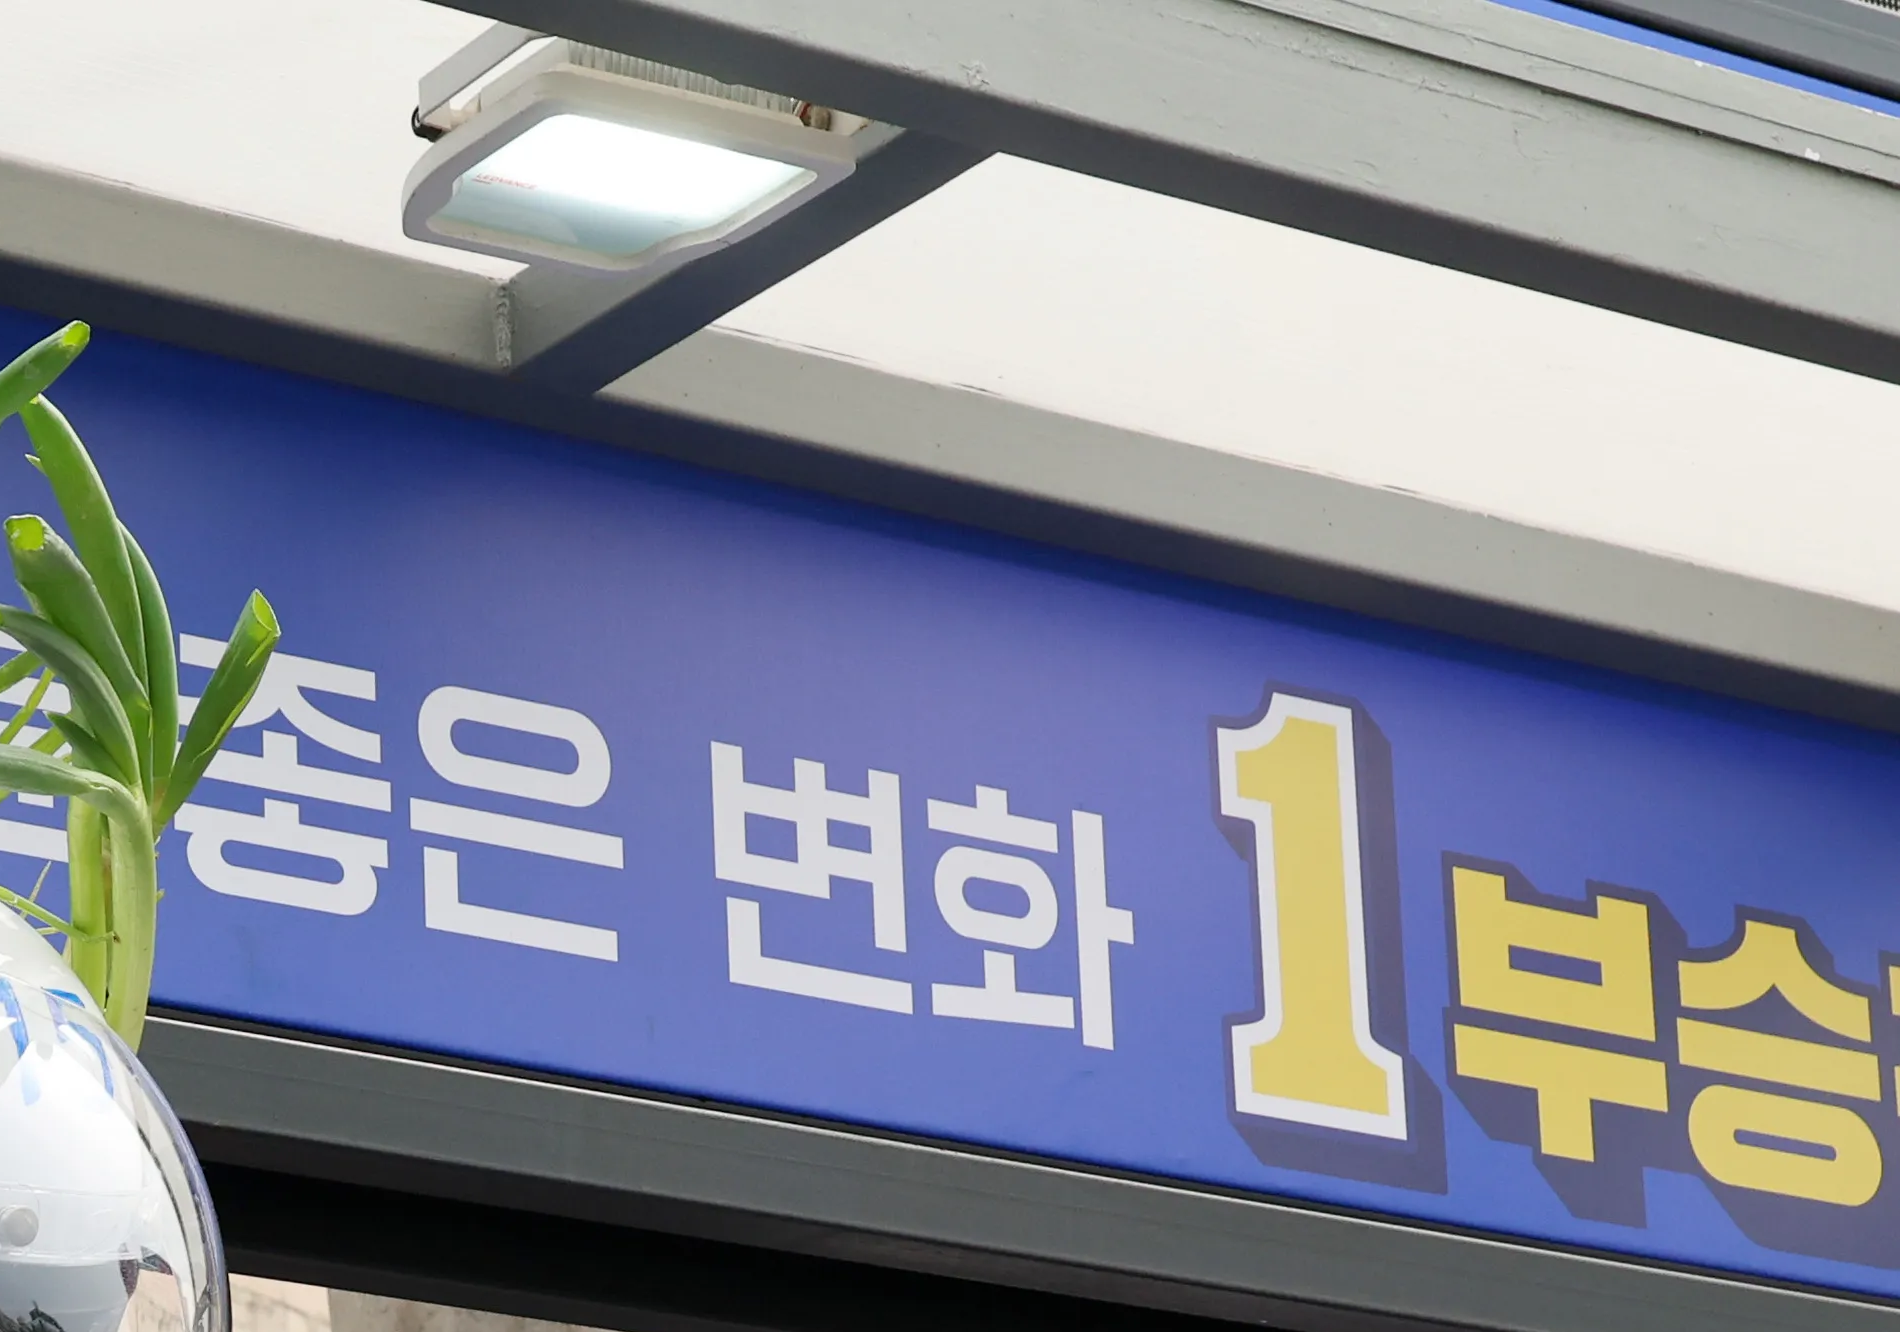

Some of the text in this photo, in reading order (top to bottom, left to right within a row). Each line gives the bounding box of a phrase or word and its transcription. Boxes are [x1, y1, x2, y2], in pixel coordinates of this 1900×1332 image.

[174, 632, 625, 962] 좋은
[710, 740, 1135, 1051] 변화
[1216, 691, 1409, 1141] 1
[1451, 865, 1900, 1209] 부승
